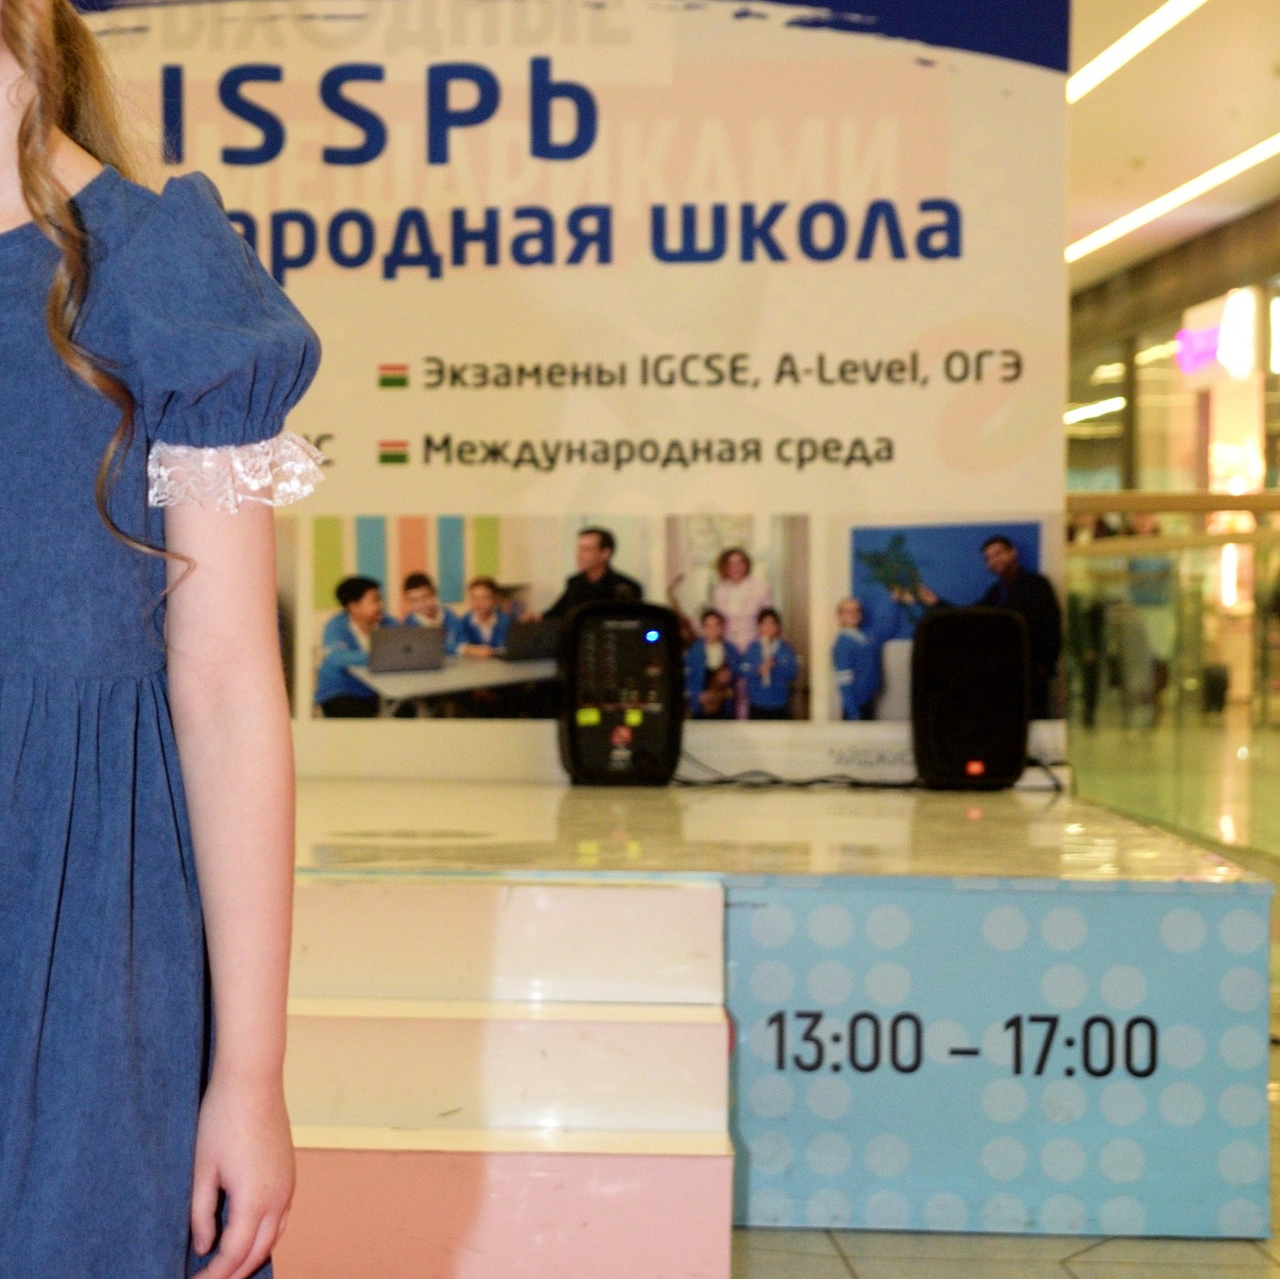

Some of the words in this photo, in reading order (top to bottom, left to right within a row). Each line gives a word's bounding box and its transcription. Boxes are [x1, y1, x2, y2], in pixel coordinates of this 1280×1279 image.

[161, 55, 600, 168] ISSPb
[227, 207, 615, 287] ародная
[650, 198, 963, 265] школа
[424, 356, 627, 390] Экзамены
[640, 352, 760, 388] IGCSE,
[774, 350, 929, 386] A-Level,
[943, 348, 1025, 384] ОГЭ
[423, 433, 762, 472] Международная
[775, 437, 895, 470] среда
[767, 1009, 925, 1076] 13:00
[1004, 1014, 1160, 1081] 17:00
